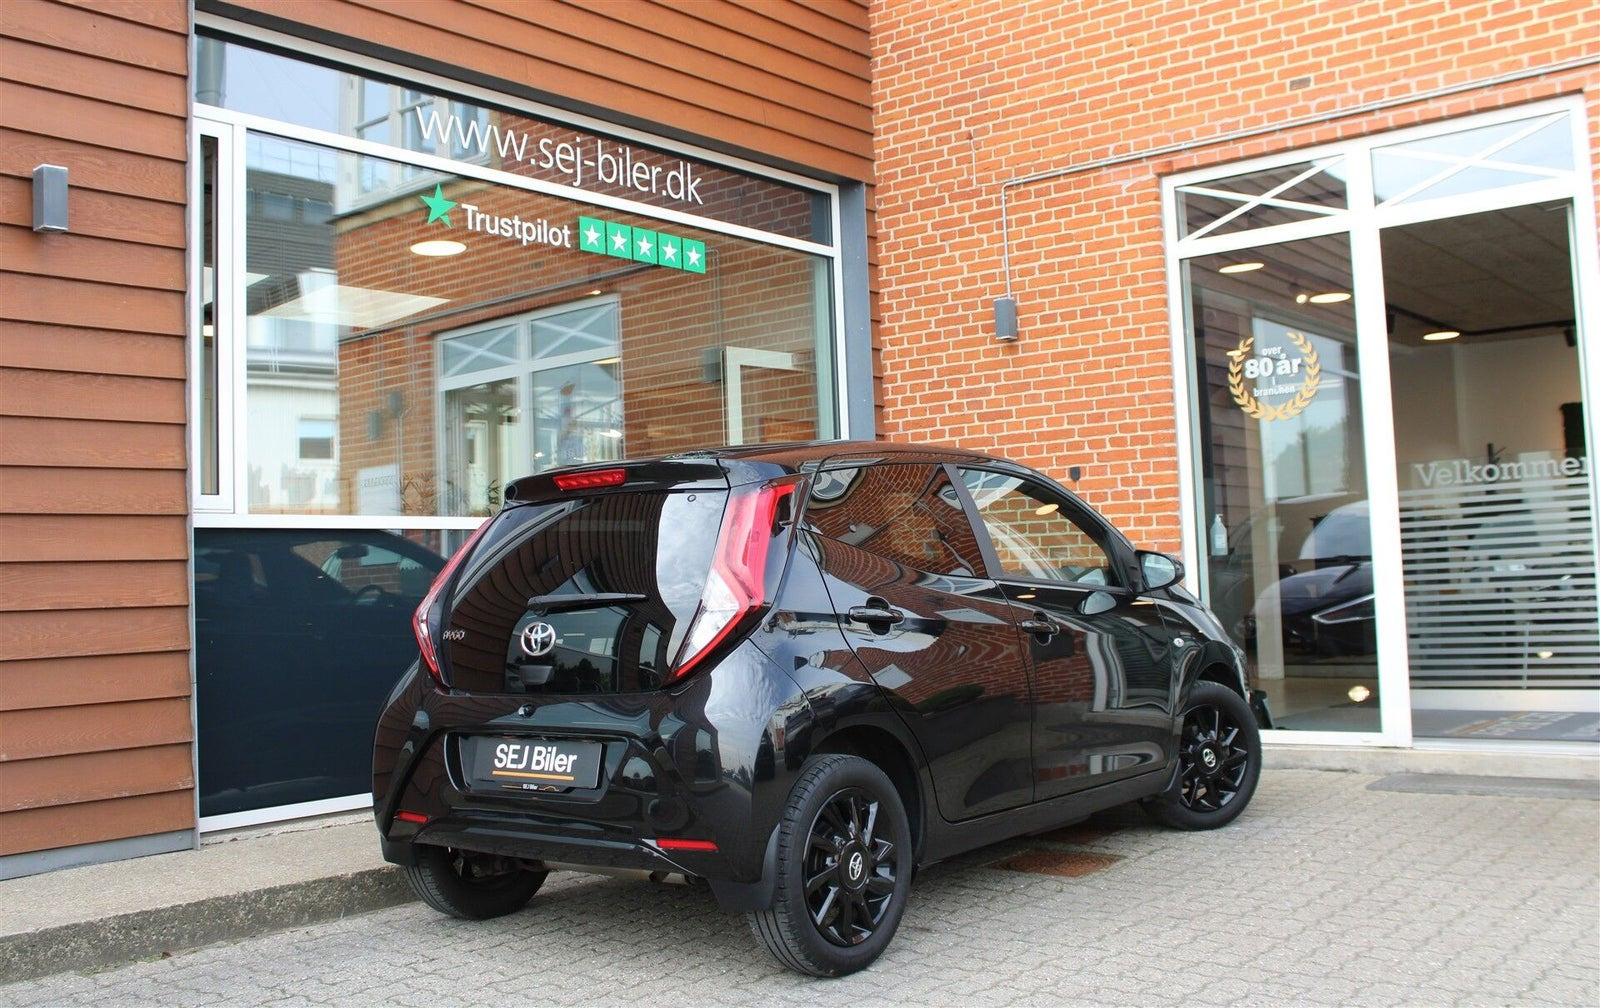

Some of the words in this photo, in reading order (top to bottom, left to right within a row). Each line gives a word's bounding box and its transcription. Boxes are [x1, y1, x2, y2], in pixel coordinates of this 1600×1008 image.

[416, 105, 704, 205] www.sej-biler.dk
[461, 203, 571, 249] Trustpilot
[1262, 346, 1282, 355] over
[1244, 356, 1274, 379] 80
[1276, 353, 1302, 376] år
[1253, 385, 1295, 397] branchen
[494, 743, 530, 770] SEJ
[530, 745, 578, 773] Biler
